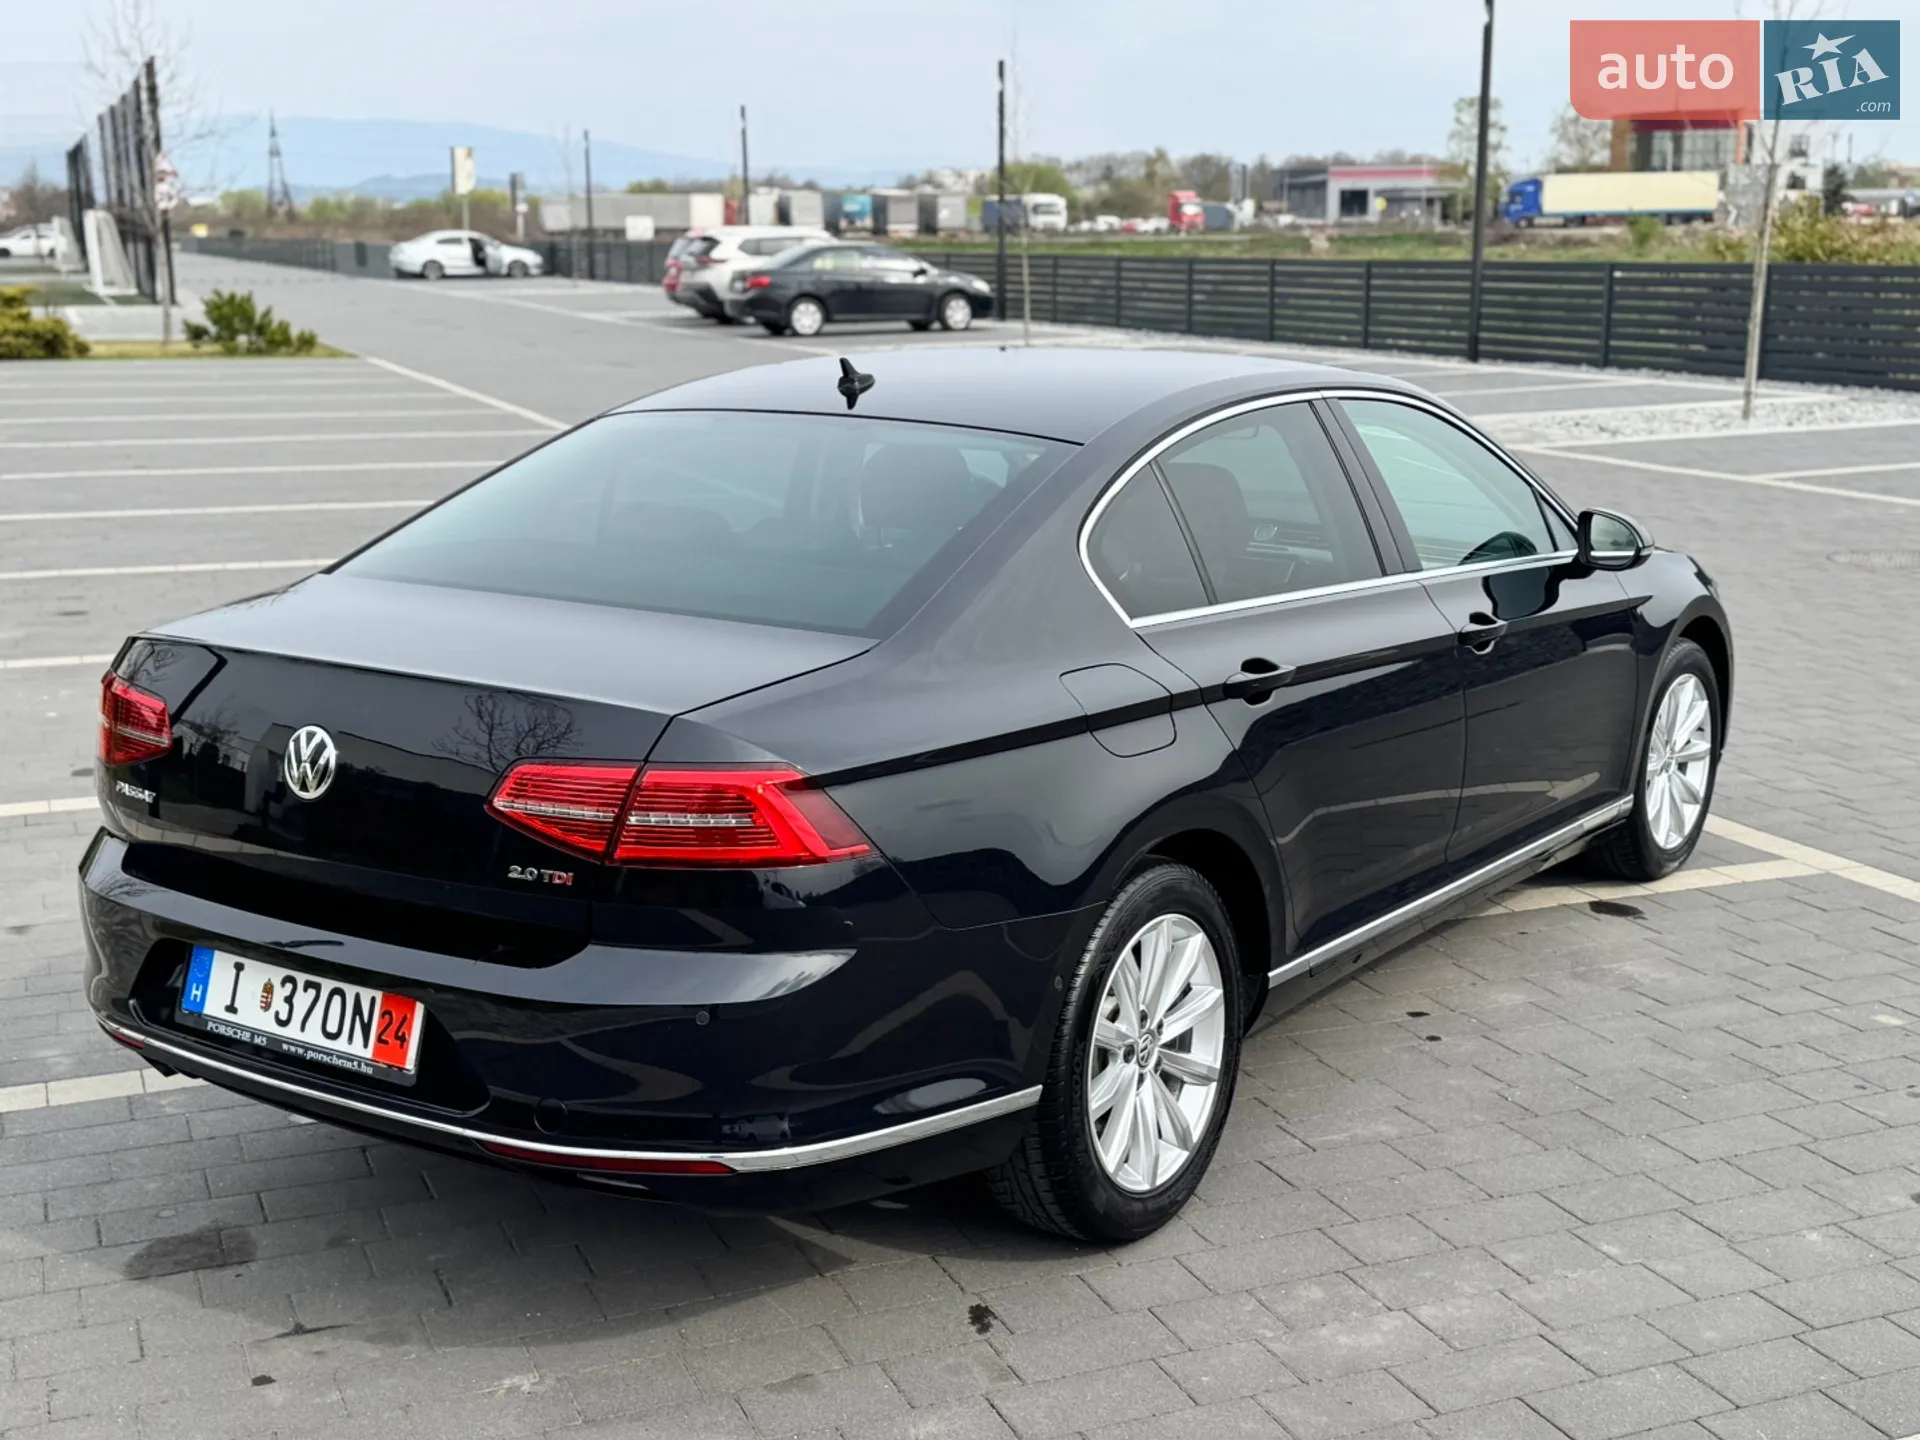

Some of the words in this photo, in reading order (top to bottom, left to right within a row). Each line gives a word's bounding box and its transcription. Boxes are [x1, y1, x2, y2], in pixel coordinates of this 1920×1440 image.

[507, 865, 538, 881] 2.0
[190, 983, 203, 1003] H
[377, 1009, 409, 1050] 24
[206, 1021, 252, 1043] PORSCHE
[253, 1033, 268, 1046] M5
[281, 1042, 374, 1075] www.porschem5.hu
